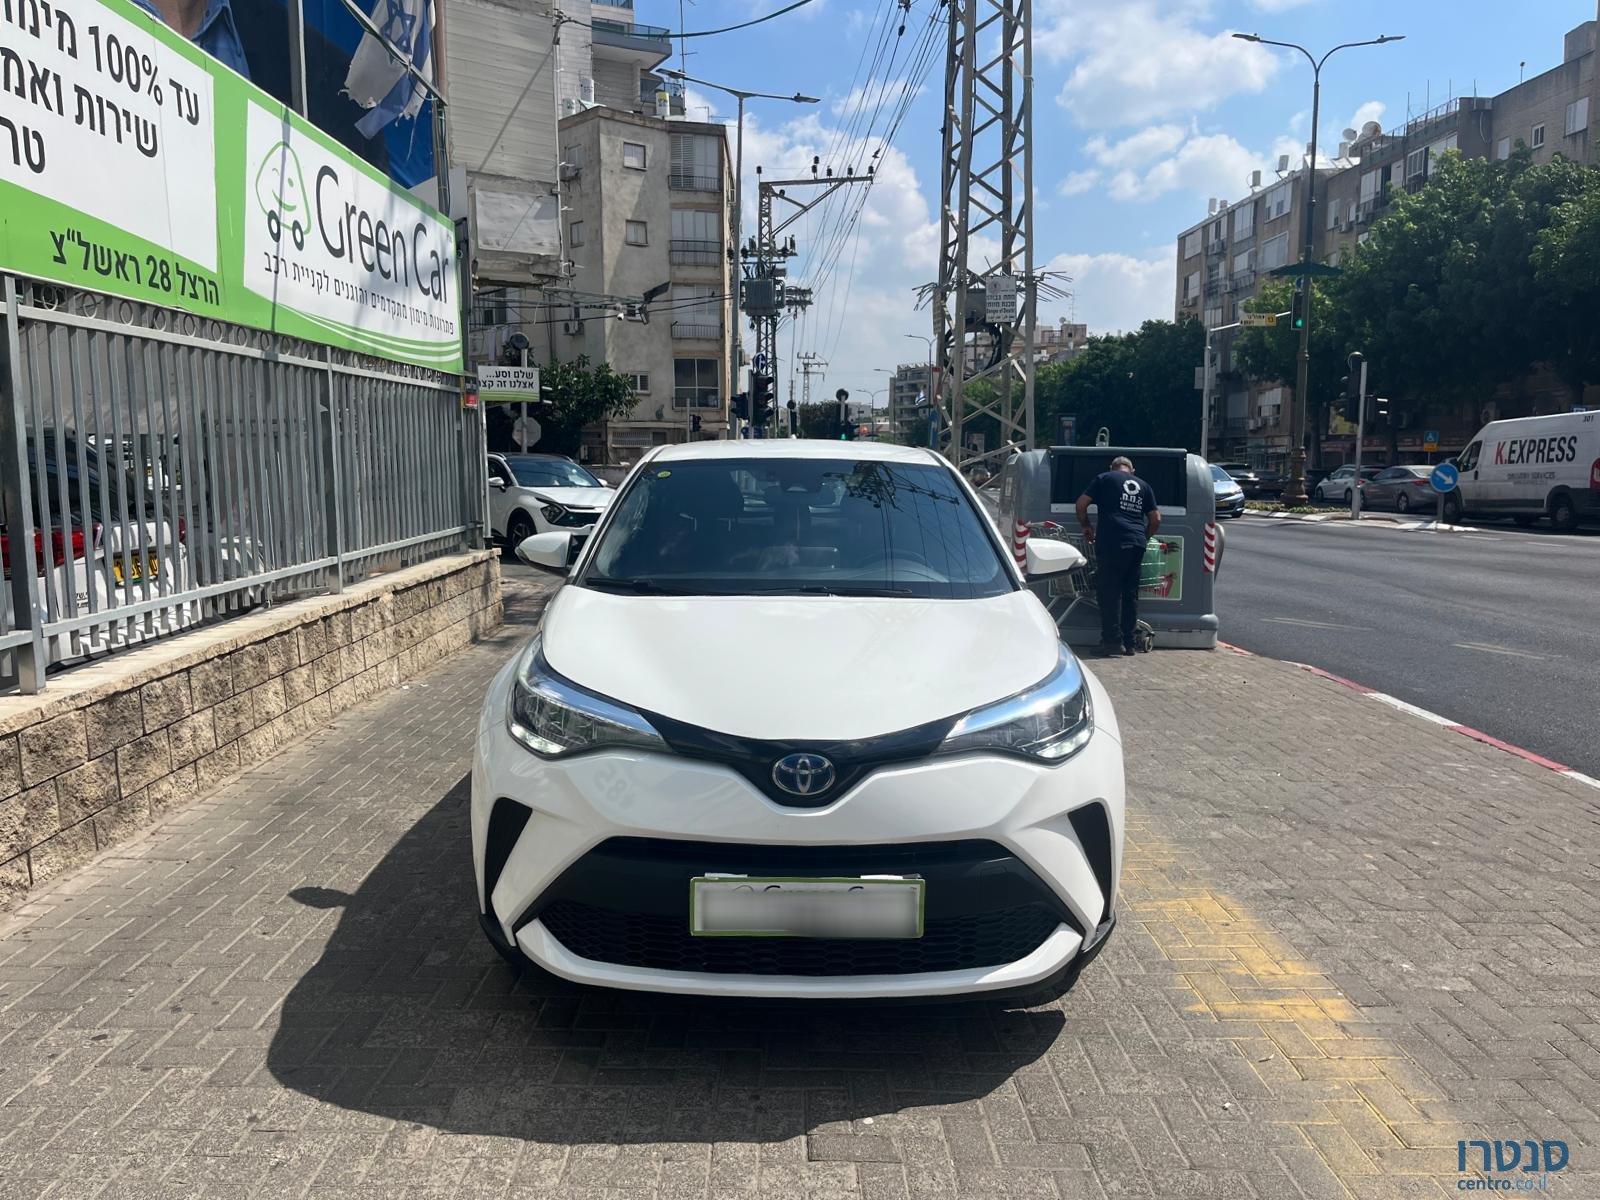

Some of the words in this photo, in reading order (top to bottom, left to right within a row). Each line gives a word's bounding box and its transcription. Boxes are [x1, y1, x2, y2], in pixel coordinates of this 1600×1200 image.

[88, 26, 163, 106] 100%
[169, 78, 200, 126] עד
[74, 84, 158, 158] שירות
[315, 165, 408, 288] Green
[413, 222, 449, 304] Car
[50, 227, 141, 285] ראשל"צ
[264, 251, 288, 278] רכב
[146, 254, 172, 292] 28
[175, 262, 220, 306] הרצל
[292, 262, 330, 296] לקניית
[334, 278, 368, 306] והוגנים
[371, 292, 408, 320] מתקדמים
[409, 306, 428, 326] מימון
[429, 314, 454, 335] פתרונות
[486, 370, 511, 379] וסע...
[496, 380, 507, 388] זה
[509, 380, 534, 389] אצלנו
[513, 369, 534, 379] שלם
[1495, 436, 1577, 465] K.EXPRESS
